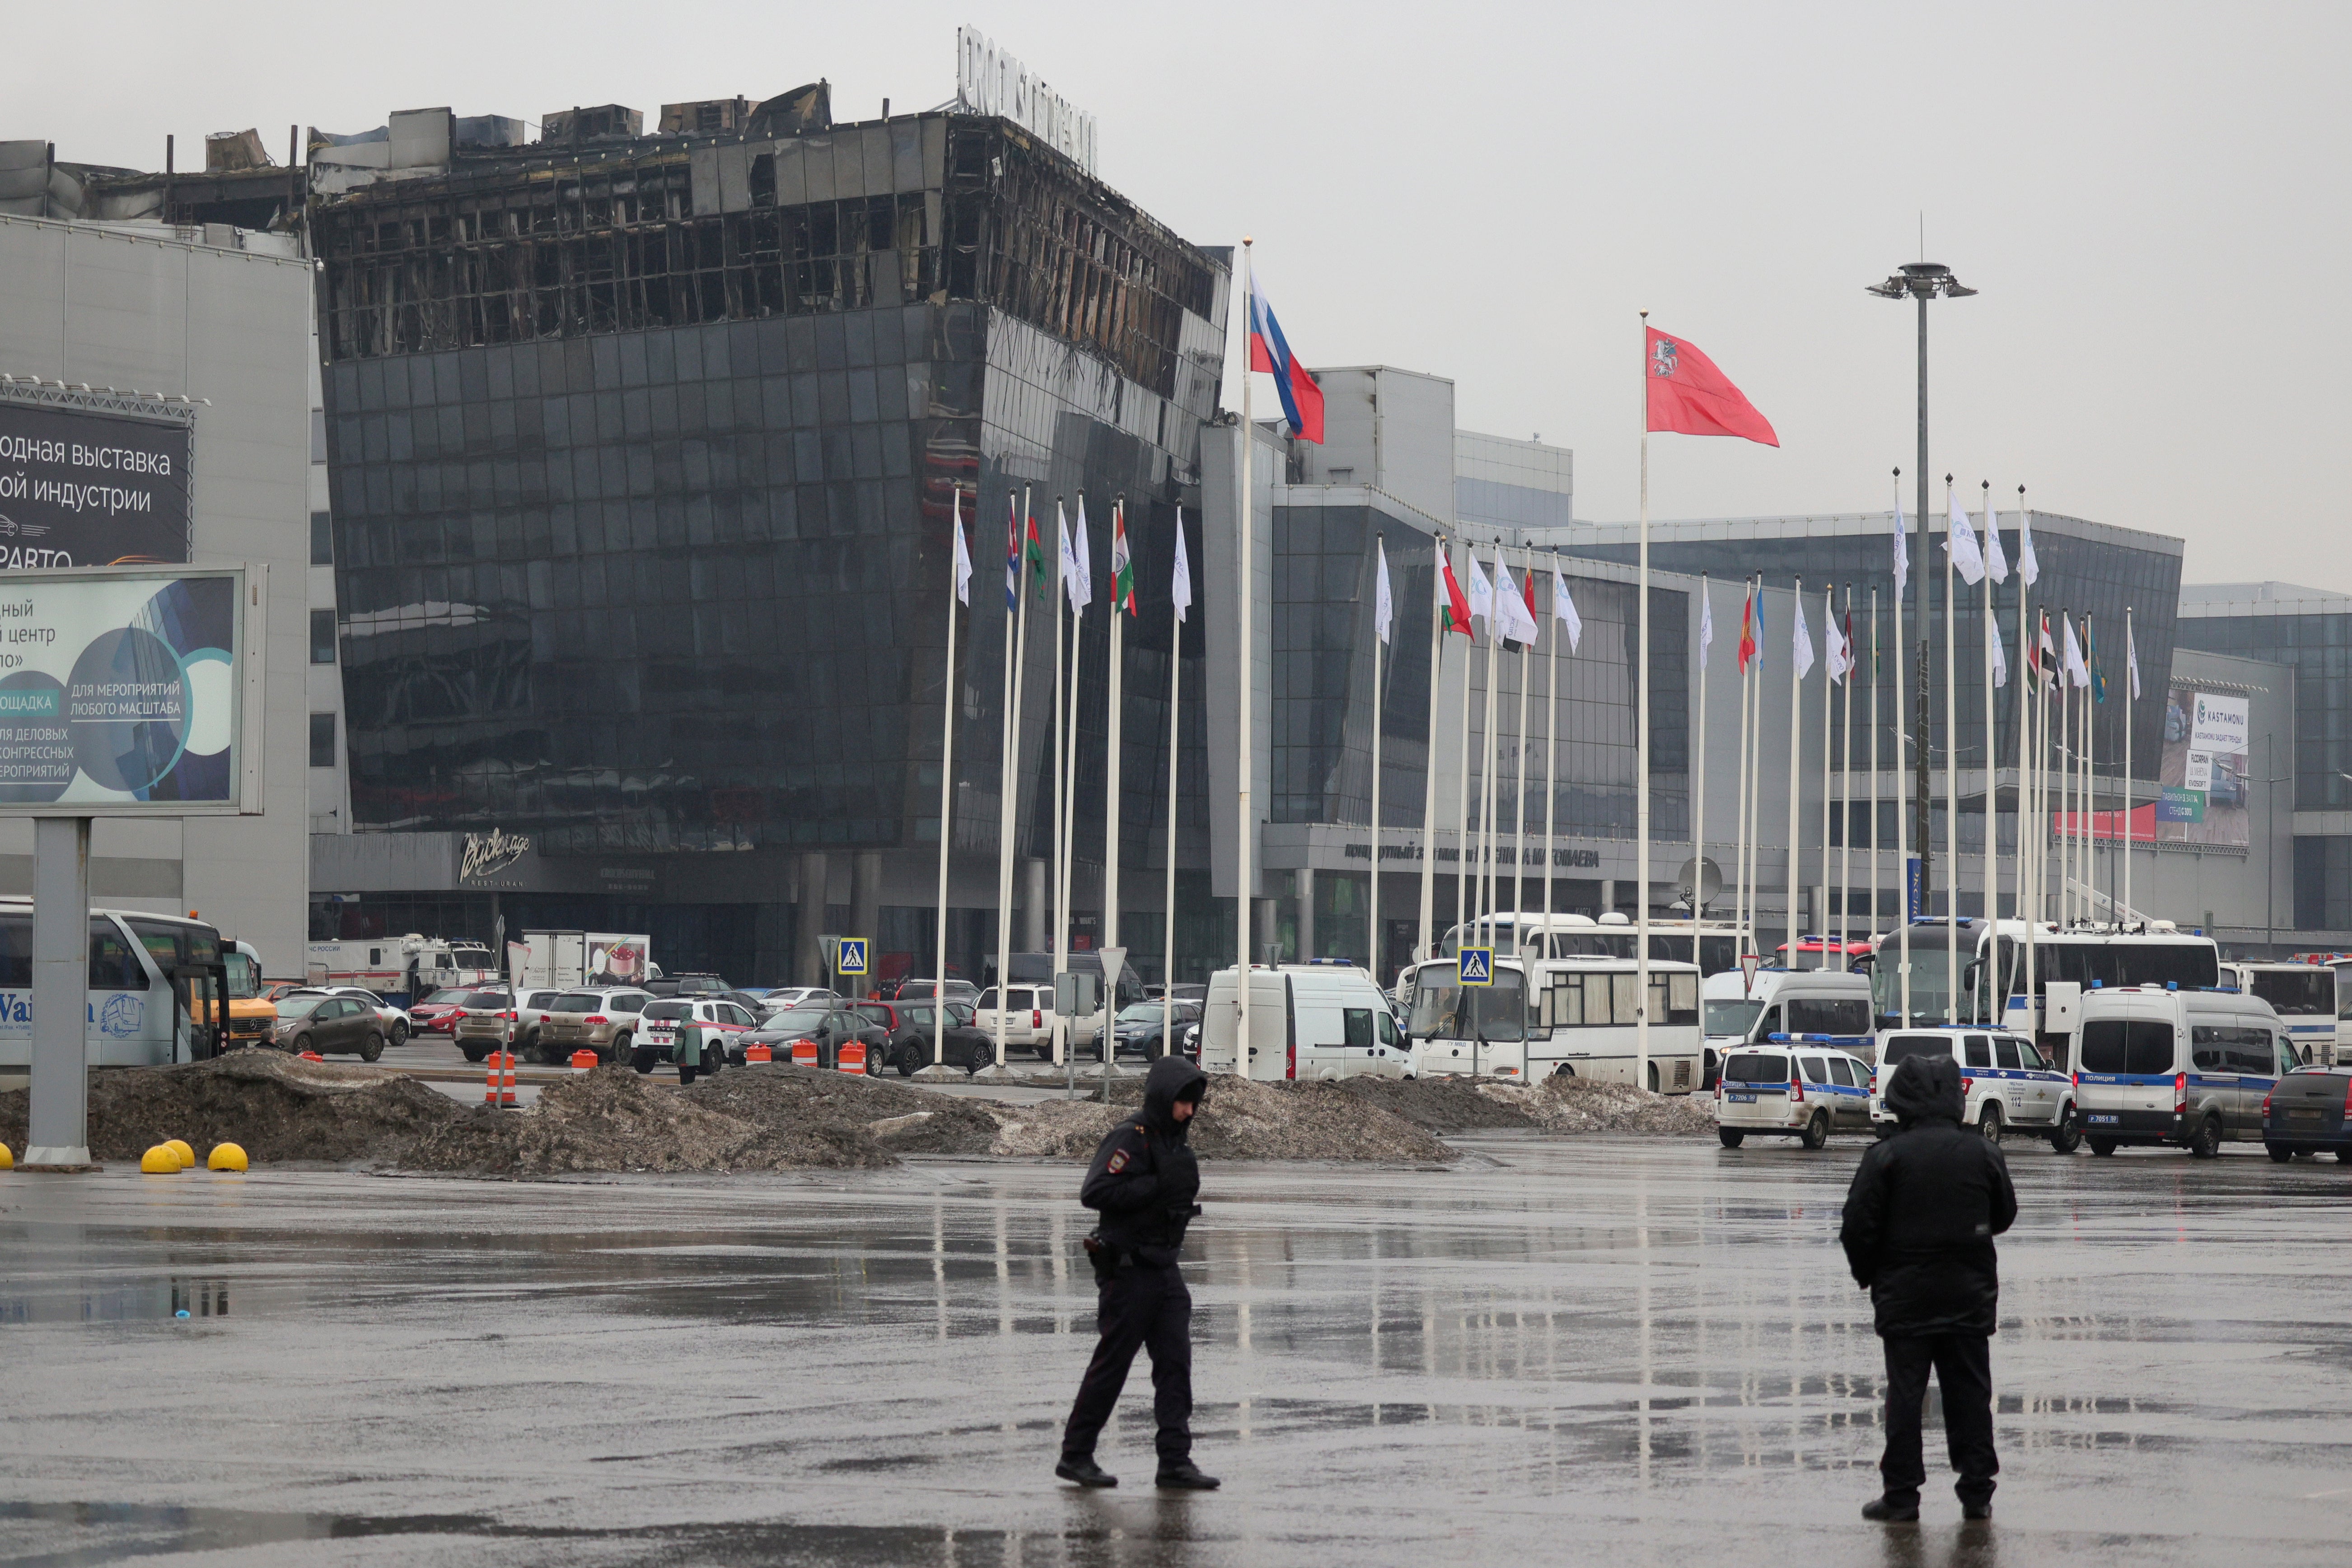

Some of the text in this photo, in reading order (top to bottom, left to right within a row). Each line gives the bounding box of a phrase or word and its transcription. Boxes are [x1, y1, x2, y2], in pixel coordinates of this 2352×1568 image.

[0, 436, 170, 475] одная выставка
[0, 471, 150, 516] ой индустрии
[0, 599, 33, 620] ный
[9, 628, 55, 646] центр
[71, 681, 180, 698] ДЛЯ МЕРОПРИЯТИЙ
[0, 696, 52, 711] ОЩАДКА
[70, 702, 180, 715] ЛЮБОГО МАСШТАБА
[2208, 711, 2244, 725] KASTAMONU
[15, 728, 68, 742] ДЕЛОВЫХ
[2191, 754, 2209, 764] FLOORPAN
[2162, 792, 2183, 802] ПАВИЛЬОН
[2169, 807, 2181, 817] СТЕНД
[2011, 1097, 2021, 1107] 112
